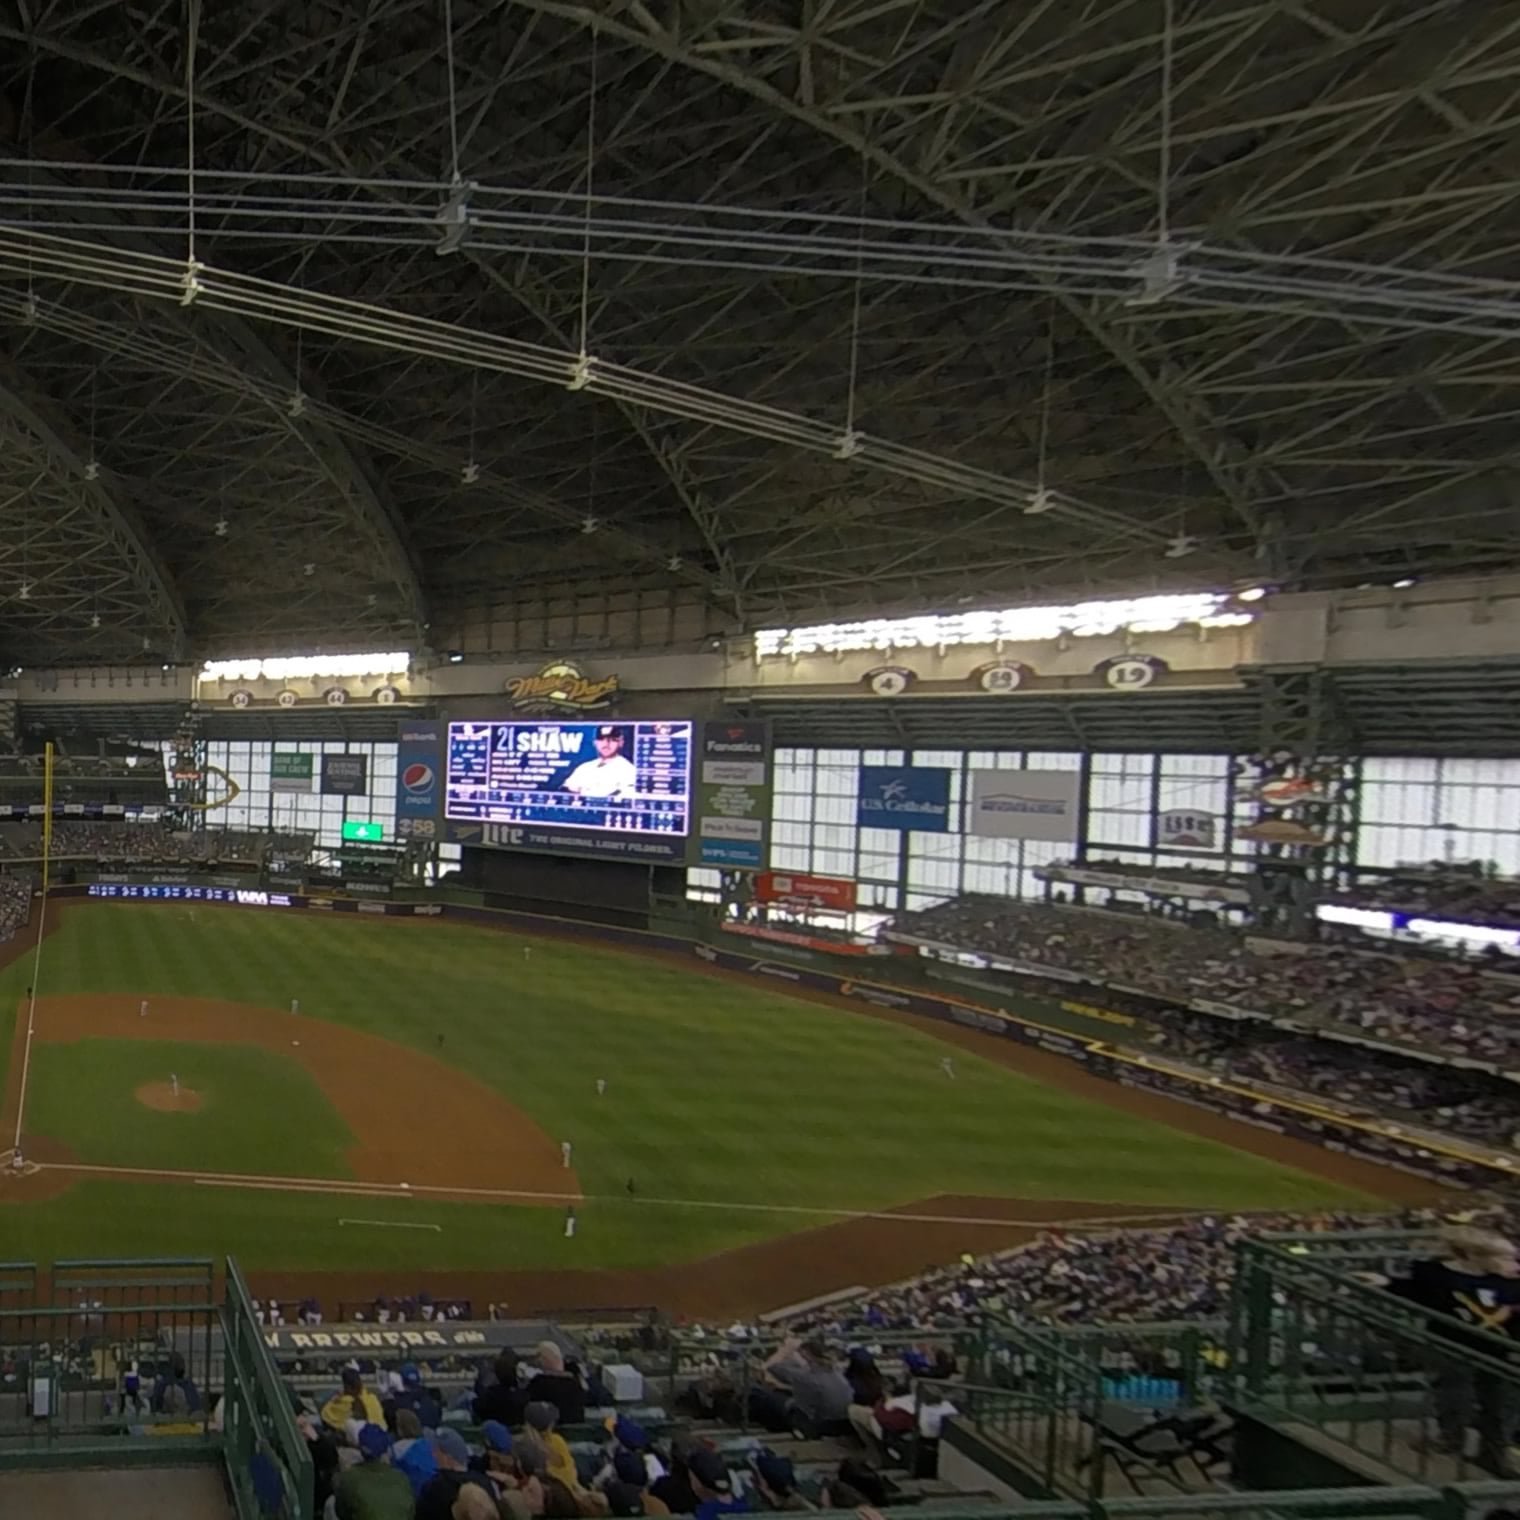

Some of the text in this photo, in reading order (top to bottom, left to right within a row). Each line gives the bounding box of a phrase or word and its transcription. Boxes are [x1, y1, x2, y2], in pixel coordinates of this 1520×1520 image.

[497, 726, 583, 753] 21 SHAW
[707, 741, 762, 753] Fanatics
[413, 818, 435, 835] 58
[481, 823, 524, 846] Lite
[289, 1331, 447, 1347] BREWERS
